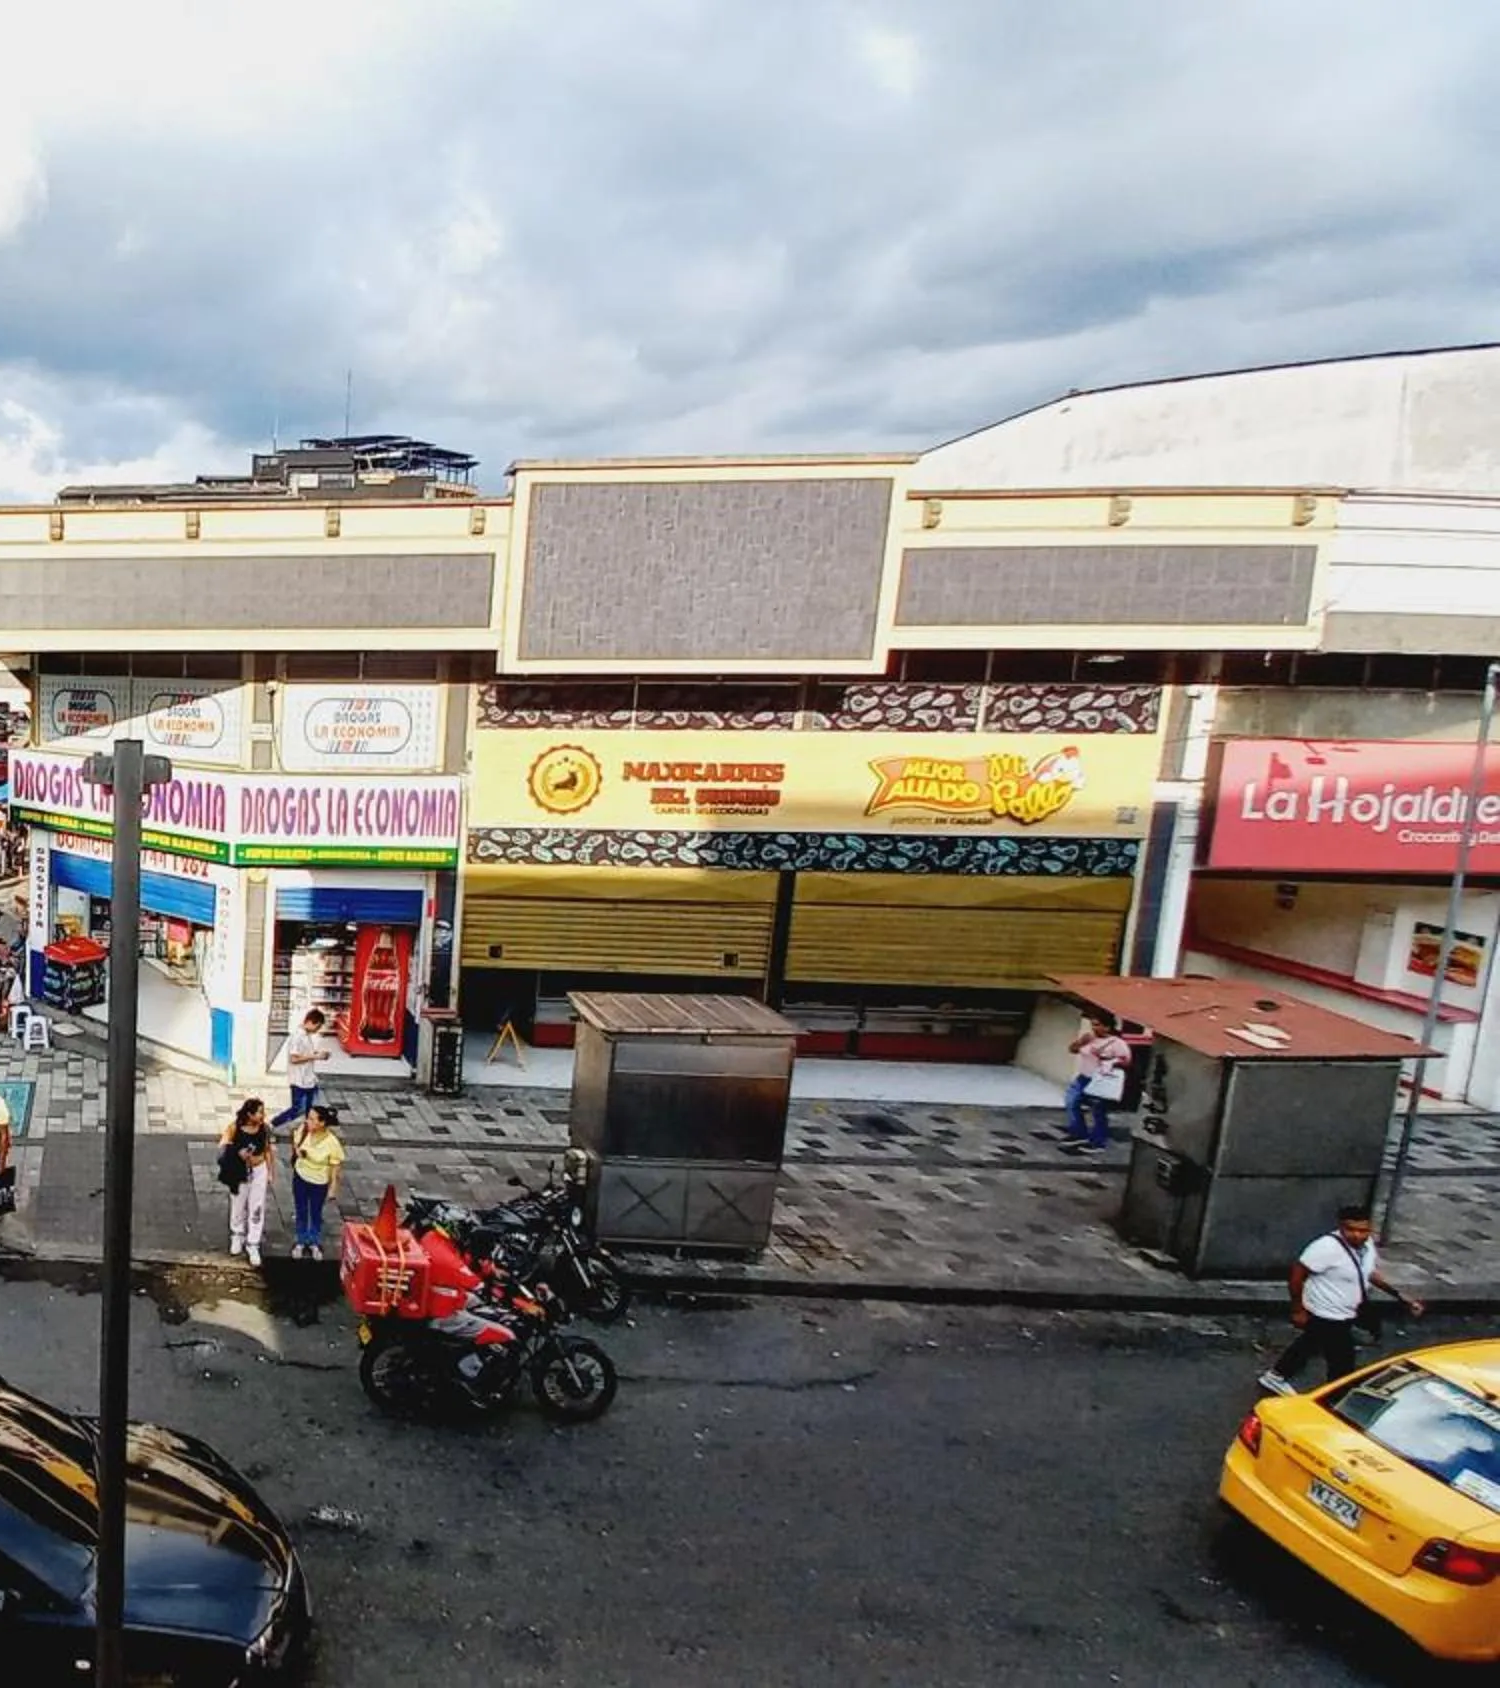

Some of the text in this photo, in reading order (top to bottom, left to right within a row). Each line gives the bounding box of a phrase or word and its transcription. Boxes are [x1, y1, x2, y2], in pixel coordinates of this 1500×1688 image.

[333, 711, 381, 724] DROGAS
[313, 725, 401, 739] LA ECONOMIA
[622, 761, 785, 783] MAXICARNES
[902, 759, 965, 780] MEJOR
[14, 759, 84, 808] DROGAS
[885, 778, 981, 803] ALIADO
[650, 787, 690, 805] DEL
[1241, 782, 1299, 821] La
[240, 786, 458, 839] DROGAS LA ECONOMIA
[35, 846, 46, 929] DROGUERIA
